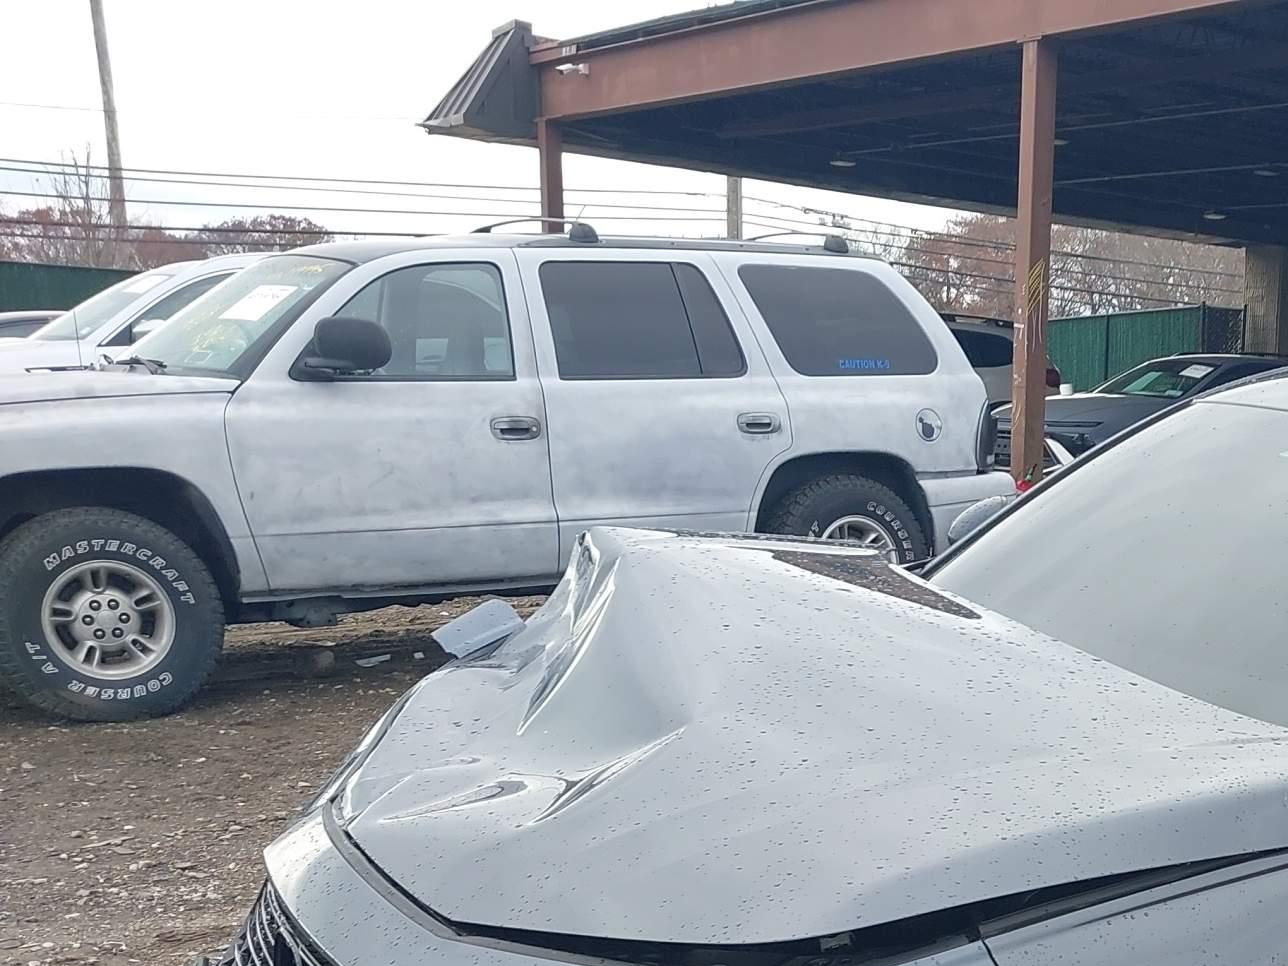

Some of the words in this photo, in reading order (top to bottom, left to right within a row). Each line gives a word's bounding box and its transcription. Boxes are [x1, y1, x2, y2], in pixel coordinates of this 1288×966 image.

[839, 359, 875, 369] CAUTION
[43, 538, 196, 604] MASTERCRAFT
[67, 671, 173, 700] COURSER
